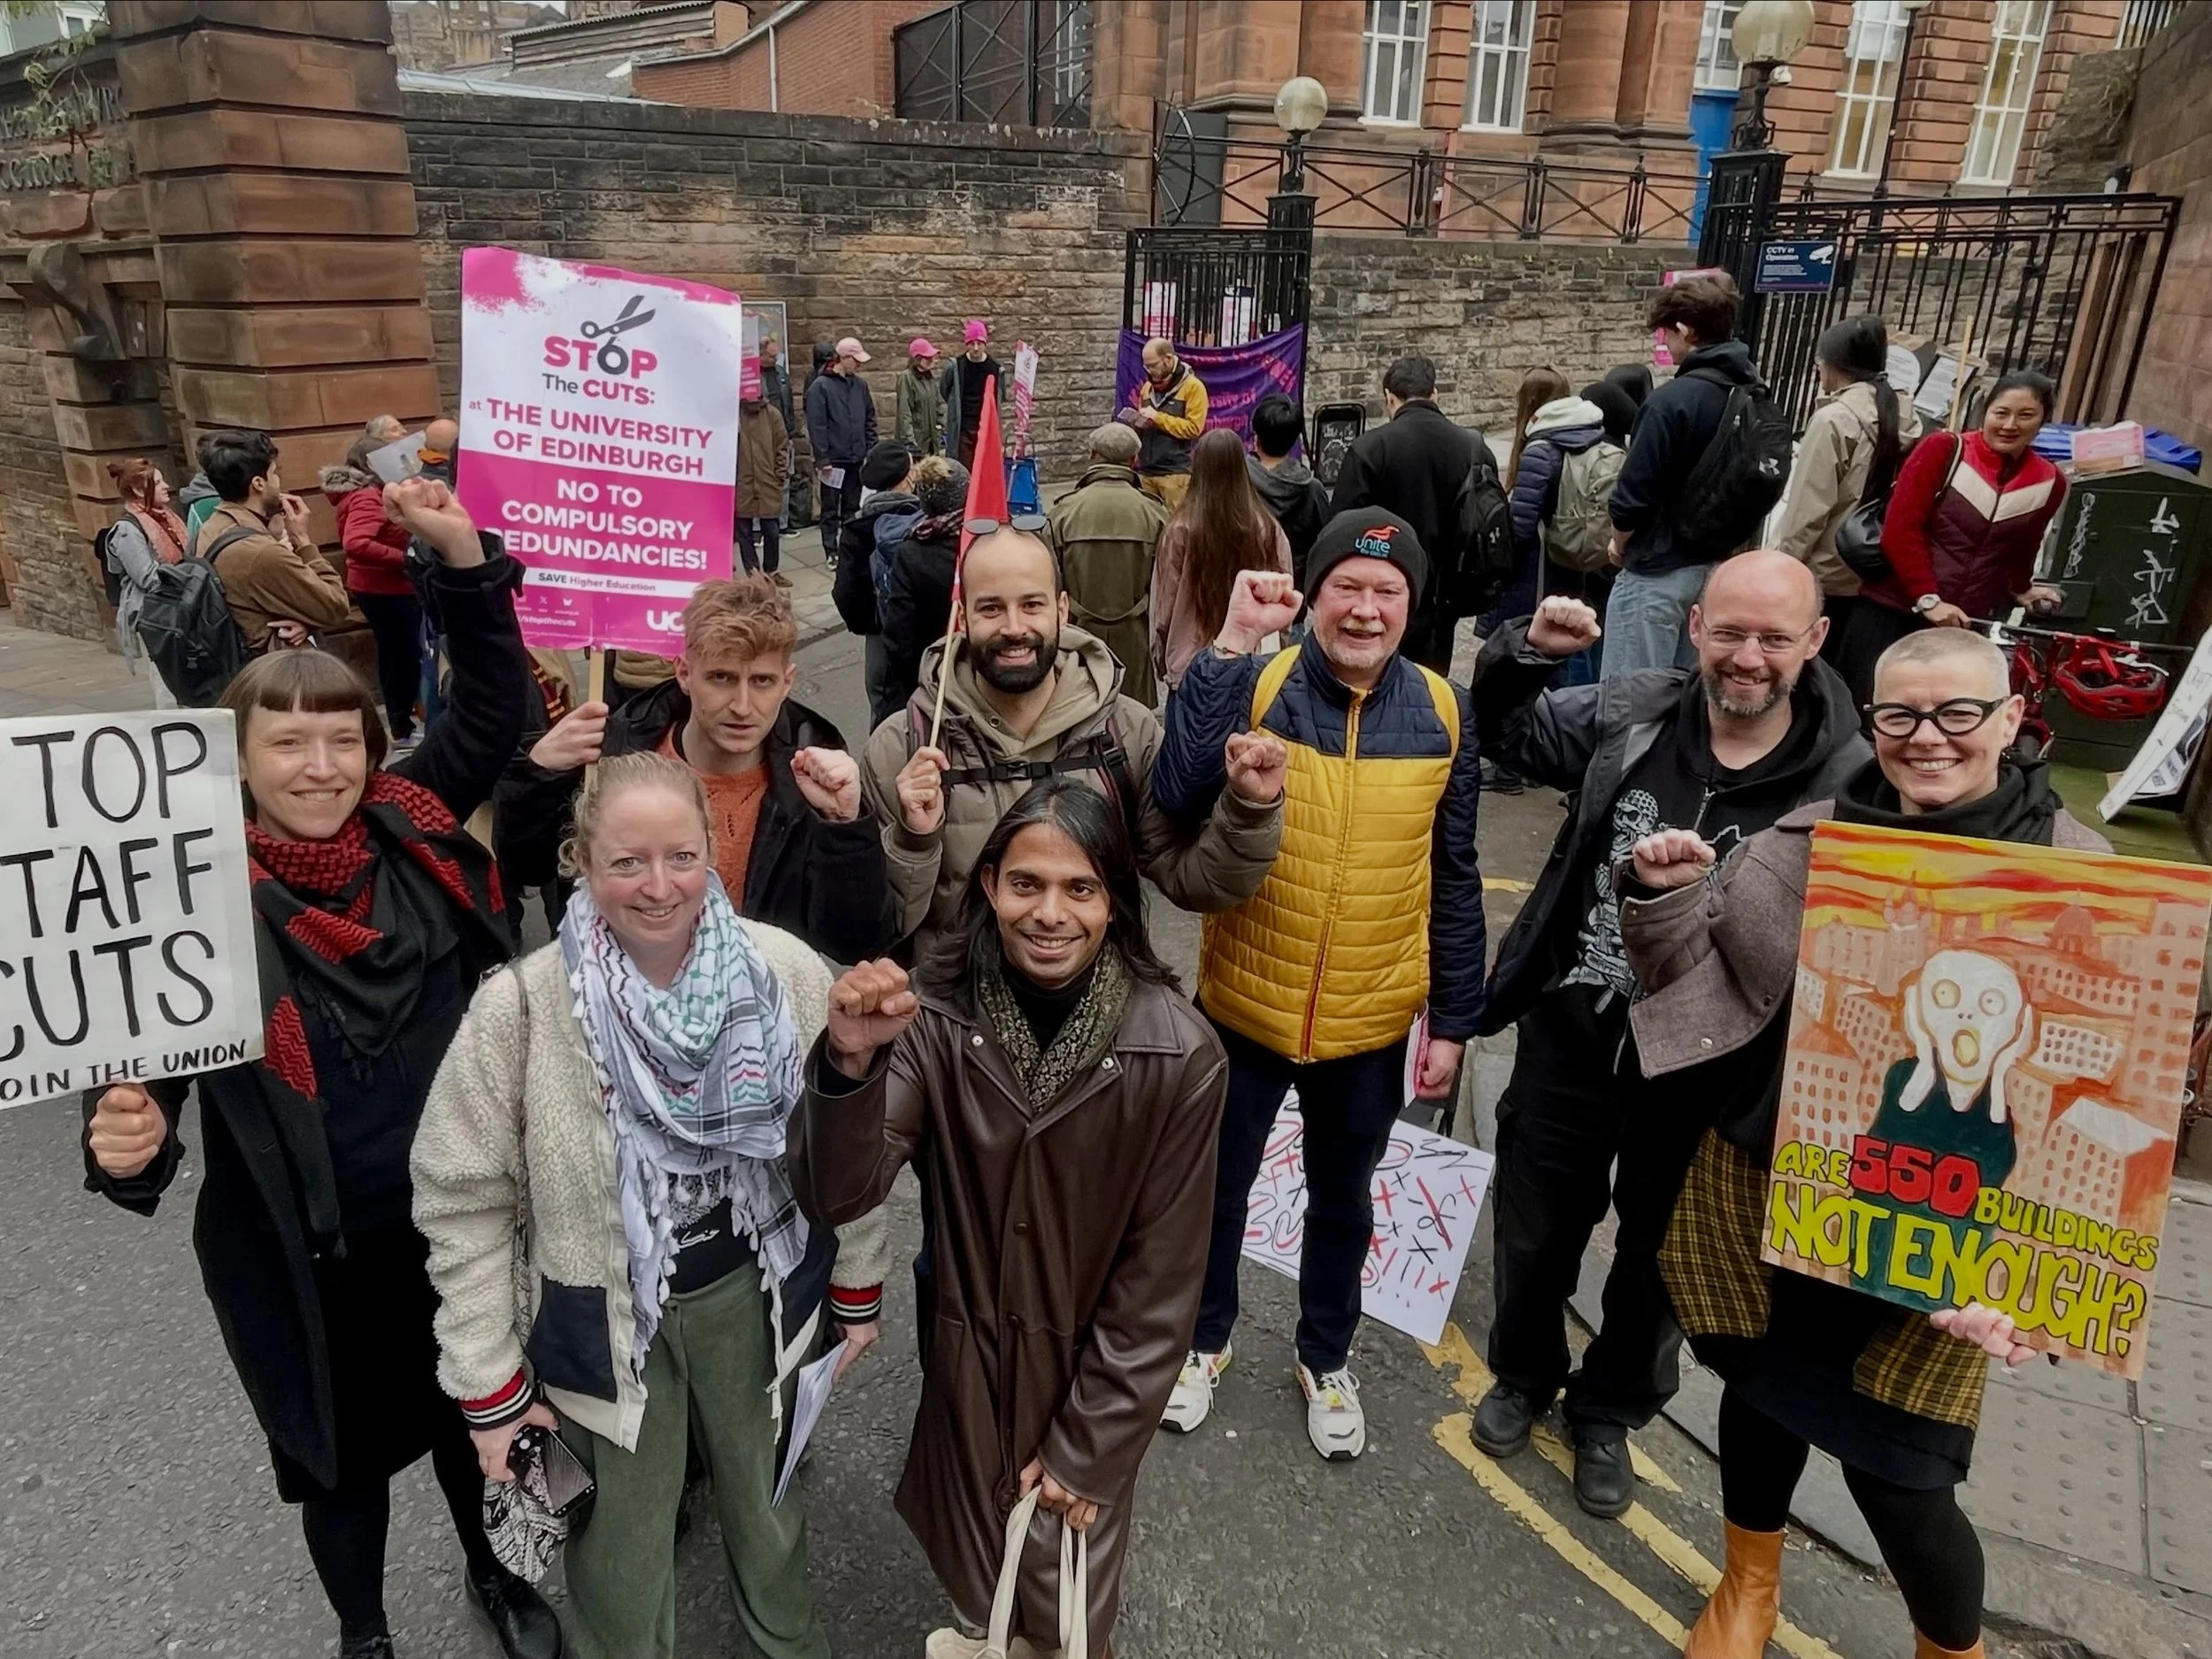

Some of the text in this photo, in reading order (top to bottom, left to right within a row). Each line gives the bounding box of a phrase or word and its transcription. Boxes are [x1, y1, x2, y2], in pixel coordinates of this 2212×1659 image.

[1766, 246, 1786, 255] CCTV
[542, 335, 657, 379] STOP
[541, 373, 655, 404] The CUTS:
[469, 397, 713, 449] at THE UNIVERSITY
[494, 429, 703, 476] OF EDINBURGH
[557, 479, 642, 508] NO TO
[502, 500, 694, 541] COMPULSORY
[1355, 537, 1391, 554] unite
[538, 572, 656, 591] SAVE Higher Education
[11, 722, 207, 828] TOP
[0, 827, 213, 938] TAFF
[0, 1039, 246, 1102] OIN THE UNION
[1773, 1134, 2160, 1272] ARE 550 BUILDINGS
[1769, 1181, 2147, 1358] NOT ENOUGH?
